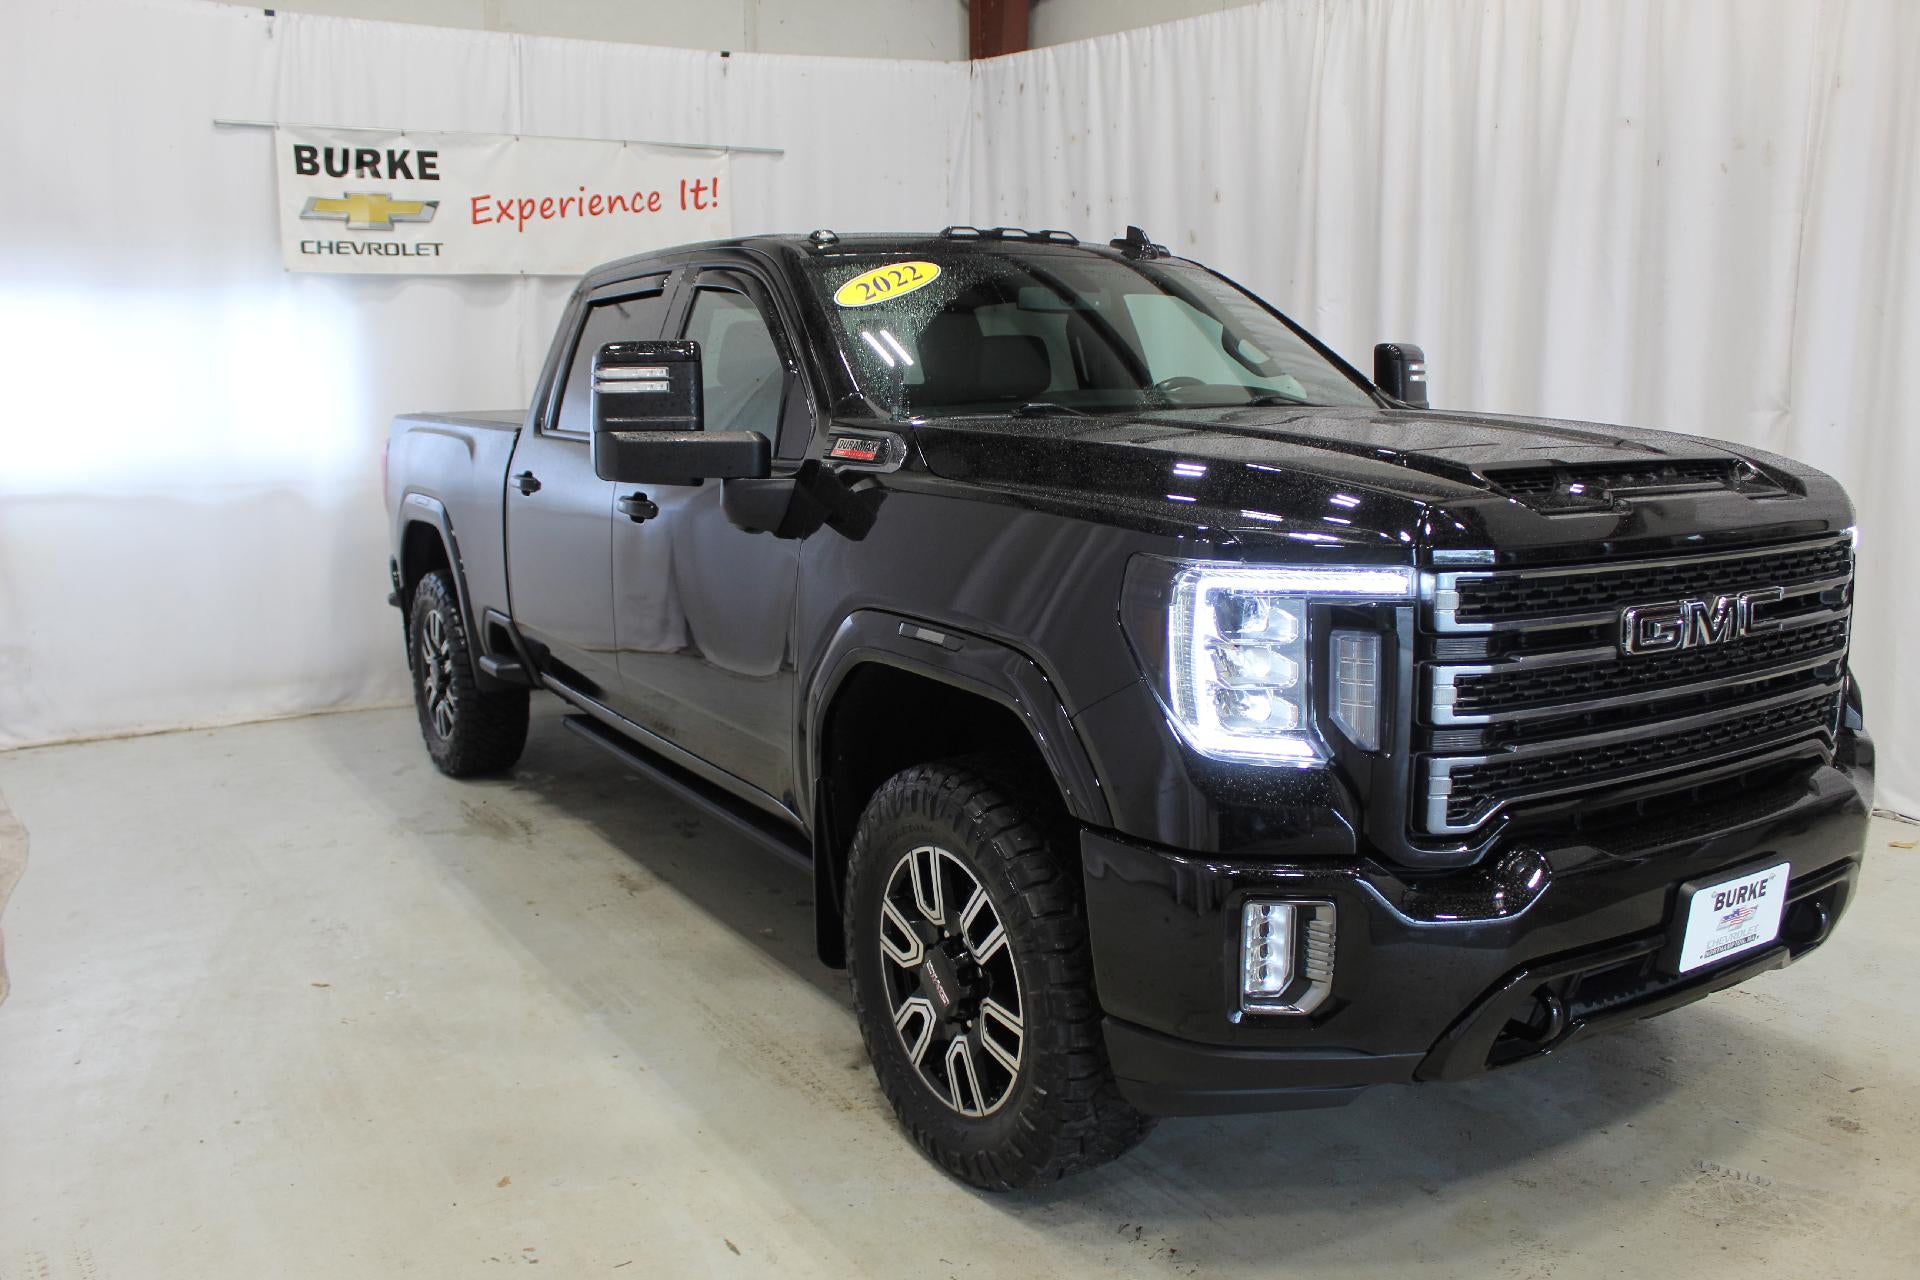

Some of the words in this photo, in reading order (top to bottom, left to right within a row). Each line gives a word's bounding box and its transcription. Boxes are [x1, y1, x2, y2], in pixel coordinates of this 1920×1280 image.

[294, 145, 440, 181] BURKE
[471, 186, 662, 232] Experience
[679, 177, 719, 211] It!
[300, 240, 444, 257] CHEVROLET
[855, 265, 923, 301] 2022
[837, 439, 880, 452] DURAMAX
[1620, 586, 1784, 656] GMC
[1713, 878, 1769, 912] BURKE
